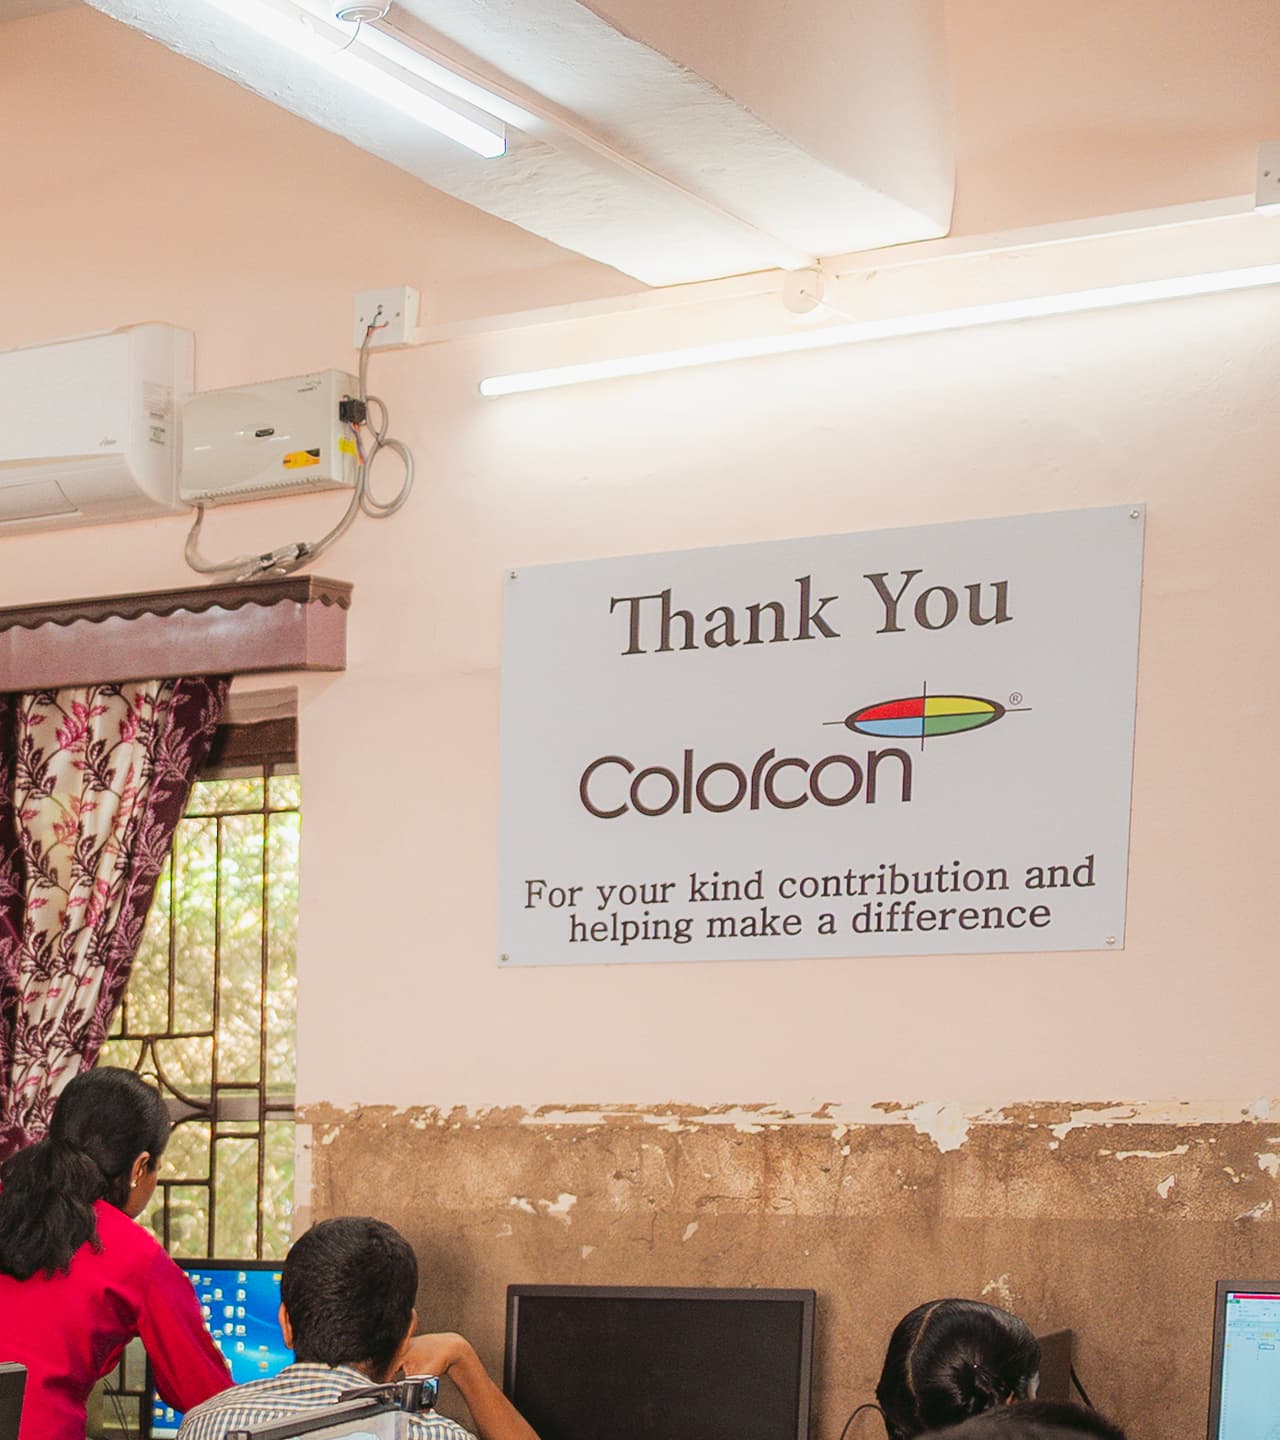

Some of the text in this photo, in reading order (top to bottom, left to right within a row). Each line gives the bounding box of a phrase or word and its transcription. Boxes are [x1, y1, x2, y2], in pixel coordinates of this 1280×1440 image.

[610, 569, 1014, 656] Thank You
[580, 748, 913, 820] Colorcon
[525, 854, 1096, 911] For your kind contribution and
[569, 900, 1051, 947] helping make a difference
